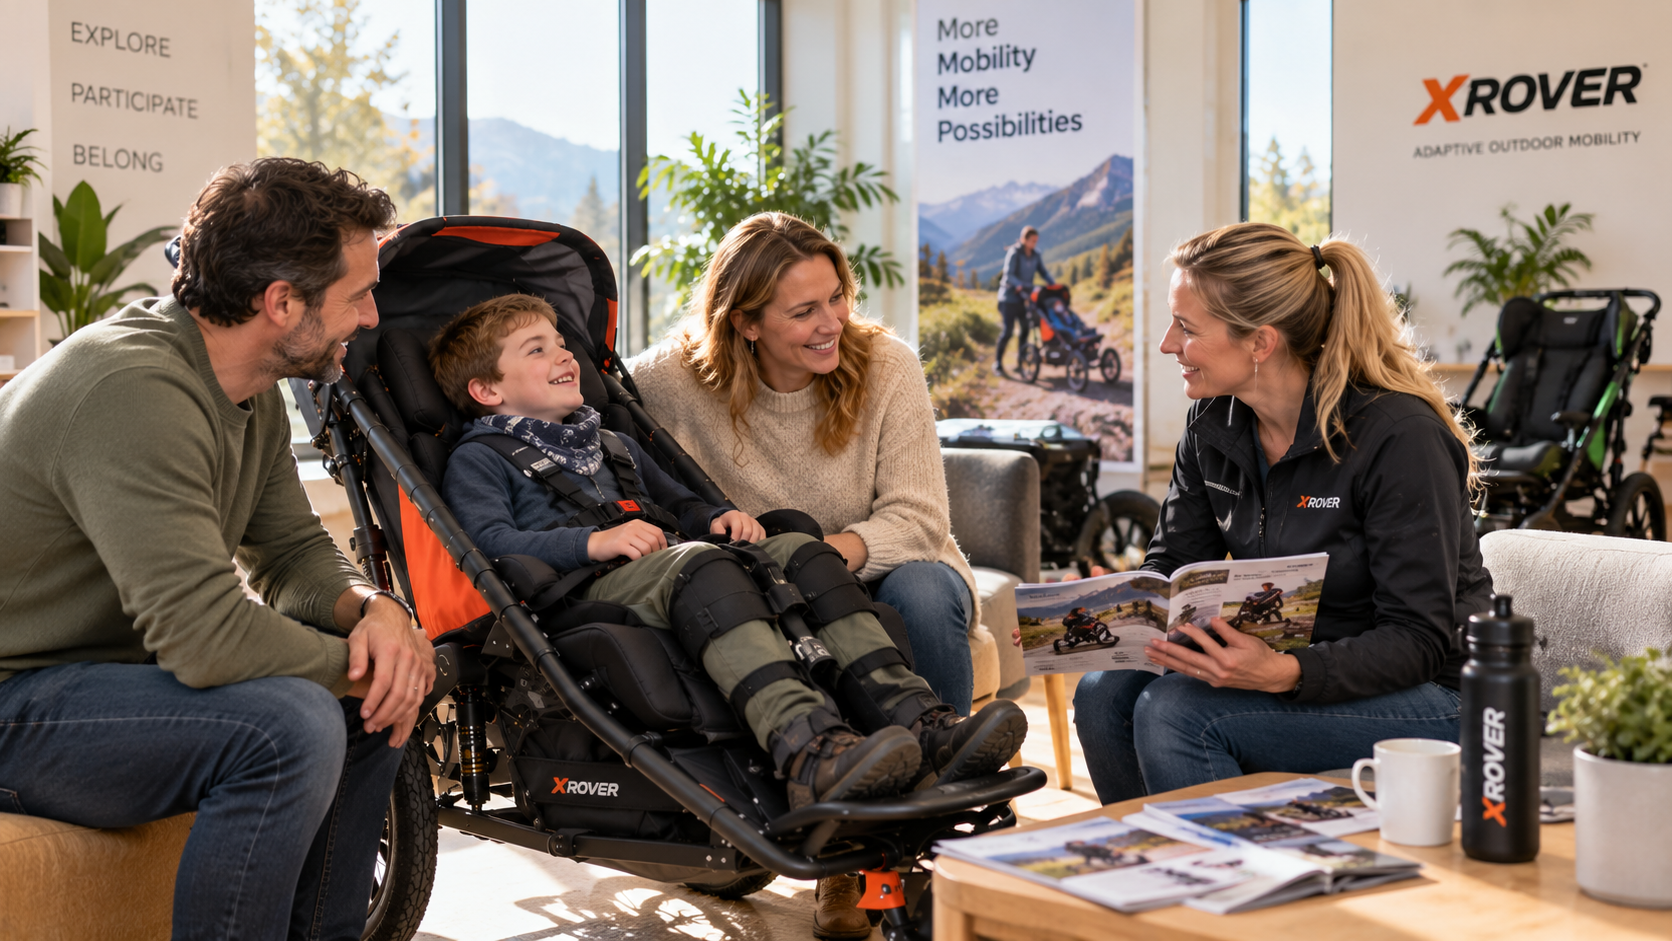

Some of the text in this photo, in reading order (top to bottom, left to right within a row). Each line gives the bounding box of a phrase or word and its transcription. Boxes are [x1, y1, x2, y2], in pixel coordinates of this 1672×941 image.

[71, 21, 171, 58] EXPLORE
[938, 17, 999, 41] More
[938, 44, 1036, 75] Mobility
[71, 82, 198, 119] PARTICIPATE
[938, 85, 999, 109] More
[1413, 65, 1642, 126] XROVER
[938, 109, 1083, 142] Possibilities
[73, 144, 163, 173] BELONG
[1413, 130, 1641, 159] ADAPTIVE OUTDOOR MOBILITY
[1297, 495, 1340, 508] XROVER
[1482, 706, 1506, 828] XROVER
[551, 776, 619, 797] XROVER
